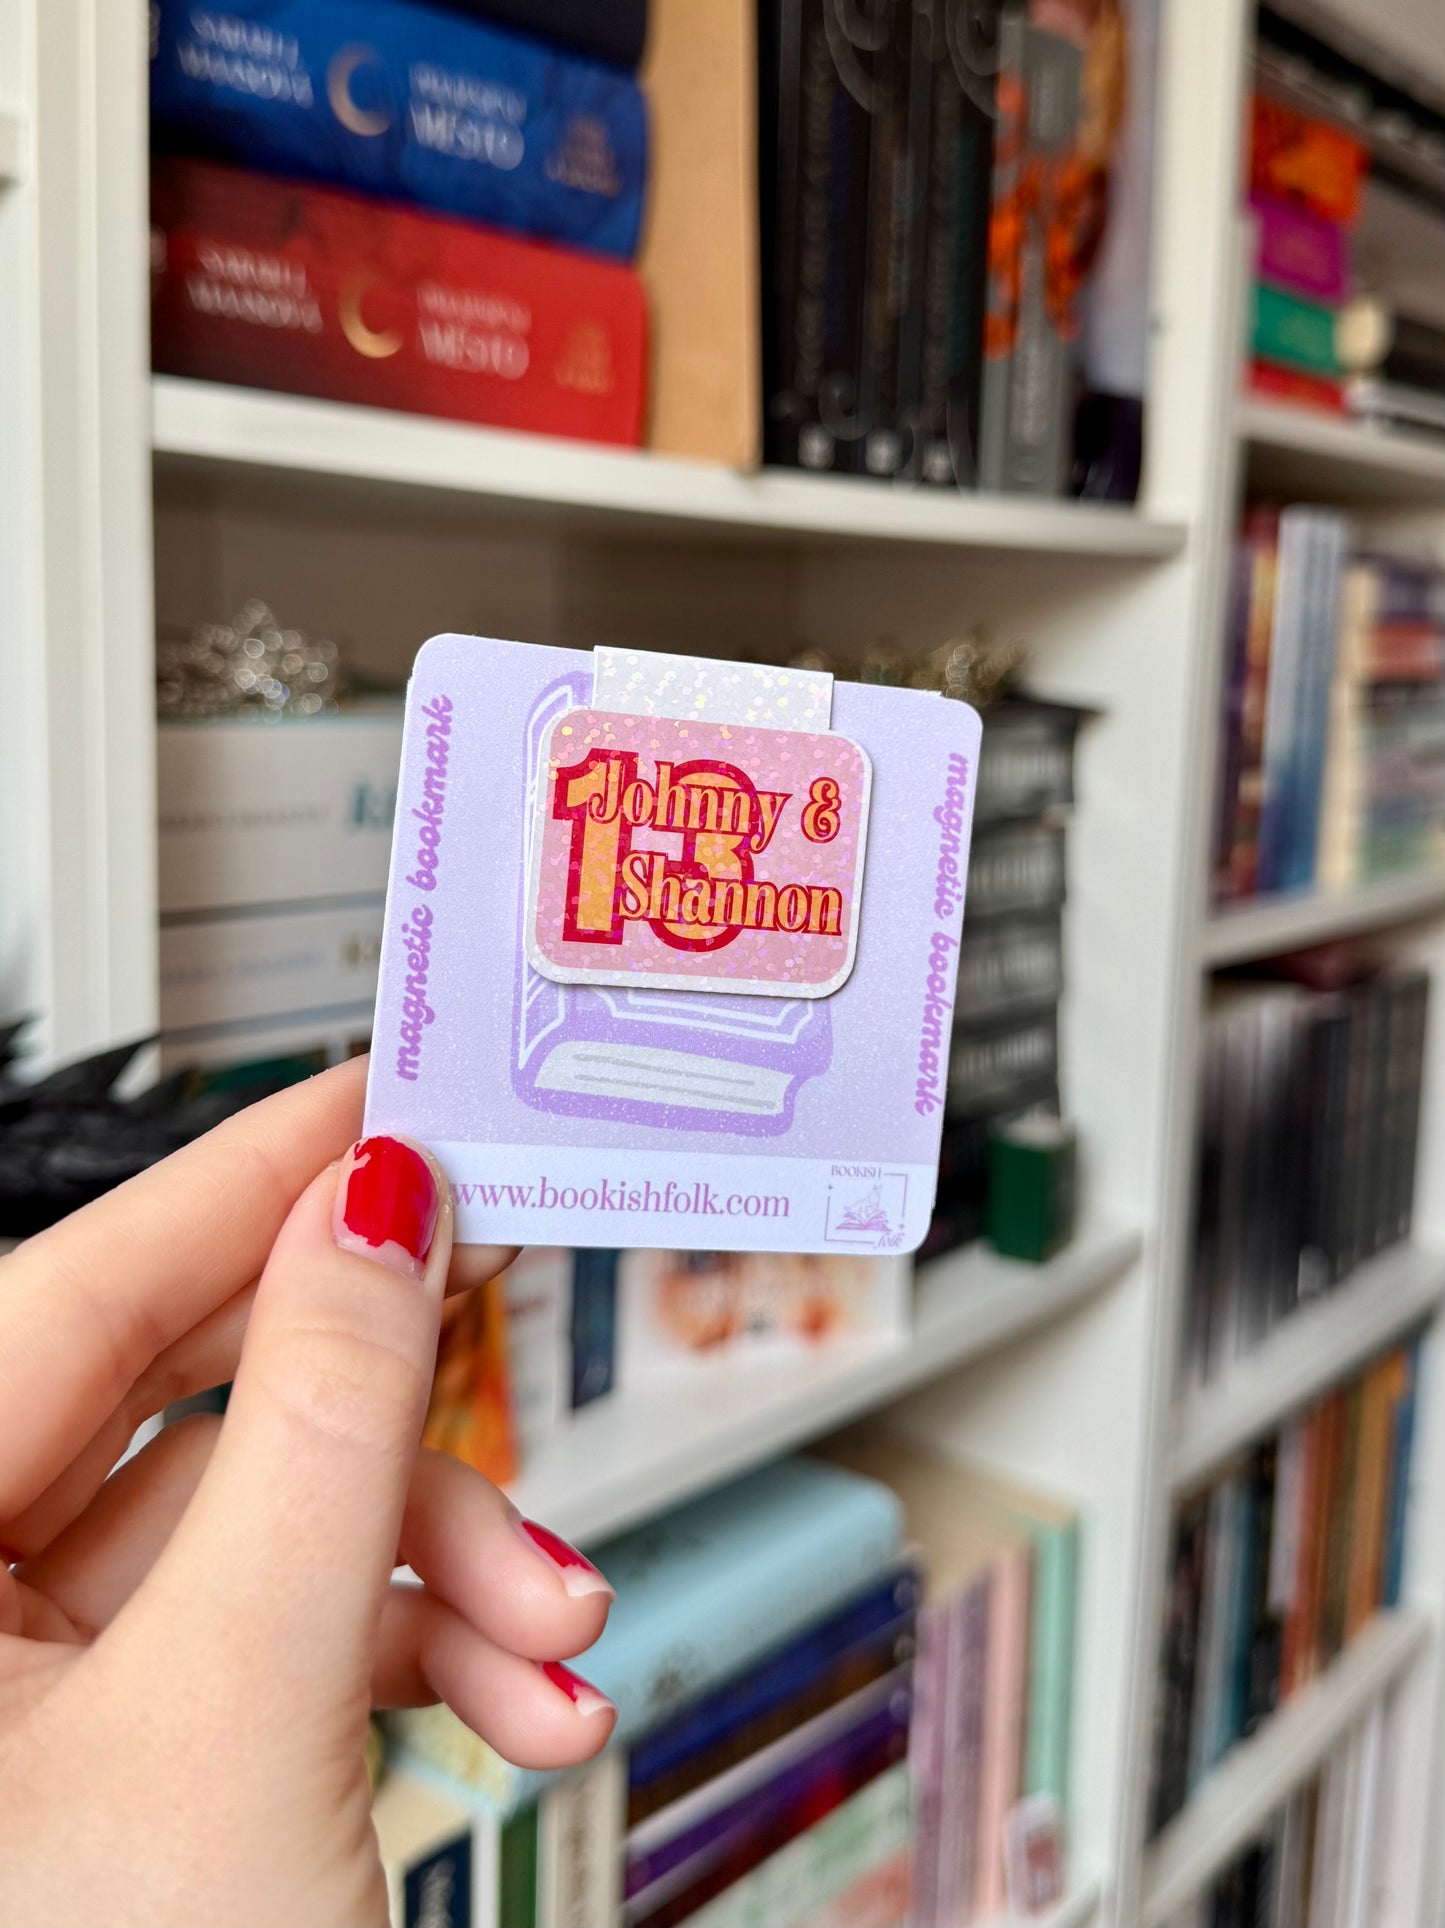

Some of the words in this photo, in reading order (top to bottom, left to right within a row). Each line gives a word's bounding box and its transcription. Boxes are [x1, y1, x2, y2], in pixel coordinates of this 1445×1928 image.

[406, 694, 454, 891] bookmark
[587, 758, 794, 854] Johnny
[800, 776, 841, 844] &
[933, 753, 968, 919] magnetic
[618, 850, 842, 936] Shannon
[397, 904, 436, 1081] magnetic
[915, 932, 958, 1116] bookmark
[449, 1176, 790, 1218] www.bookishfolk.com
[831, 1164, 882, 1179] BOOKISH
